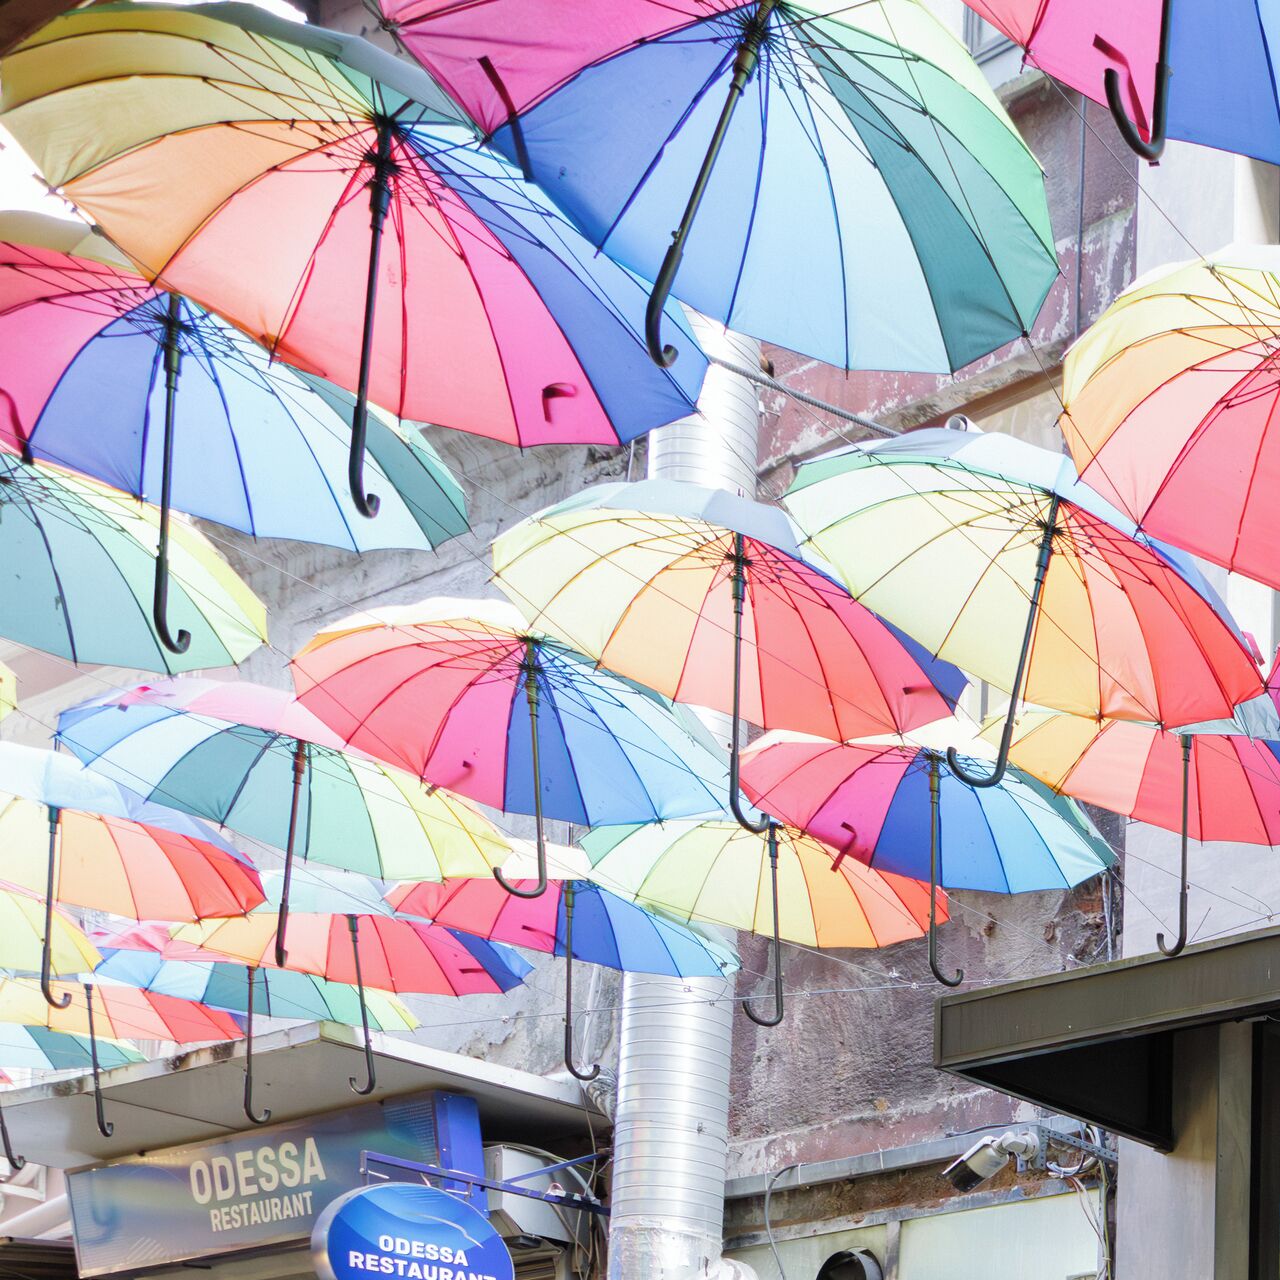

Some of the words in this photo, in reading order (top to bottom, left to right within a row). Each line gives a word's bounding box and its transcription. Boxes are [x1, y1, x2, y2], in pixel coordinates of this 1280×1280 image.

[190, 1137, 327, 1205] ODESSA
[210, 1191, 313, 1233] RESTAURANT
[378, 1234, 469, 1267] ODESSA
